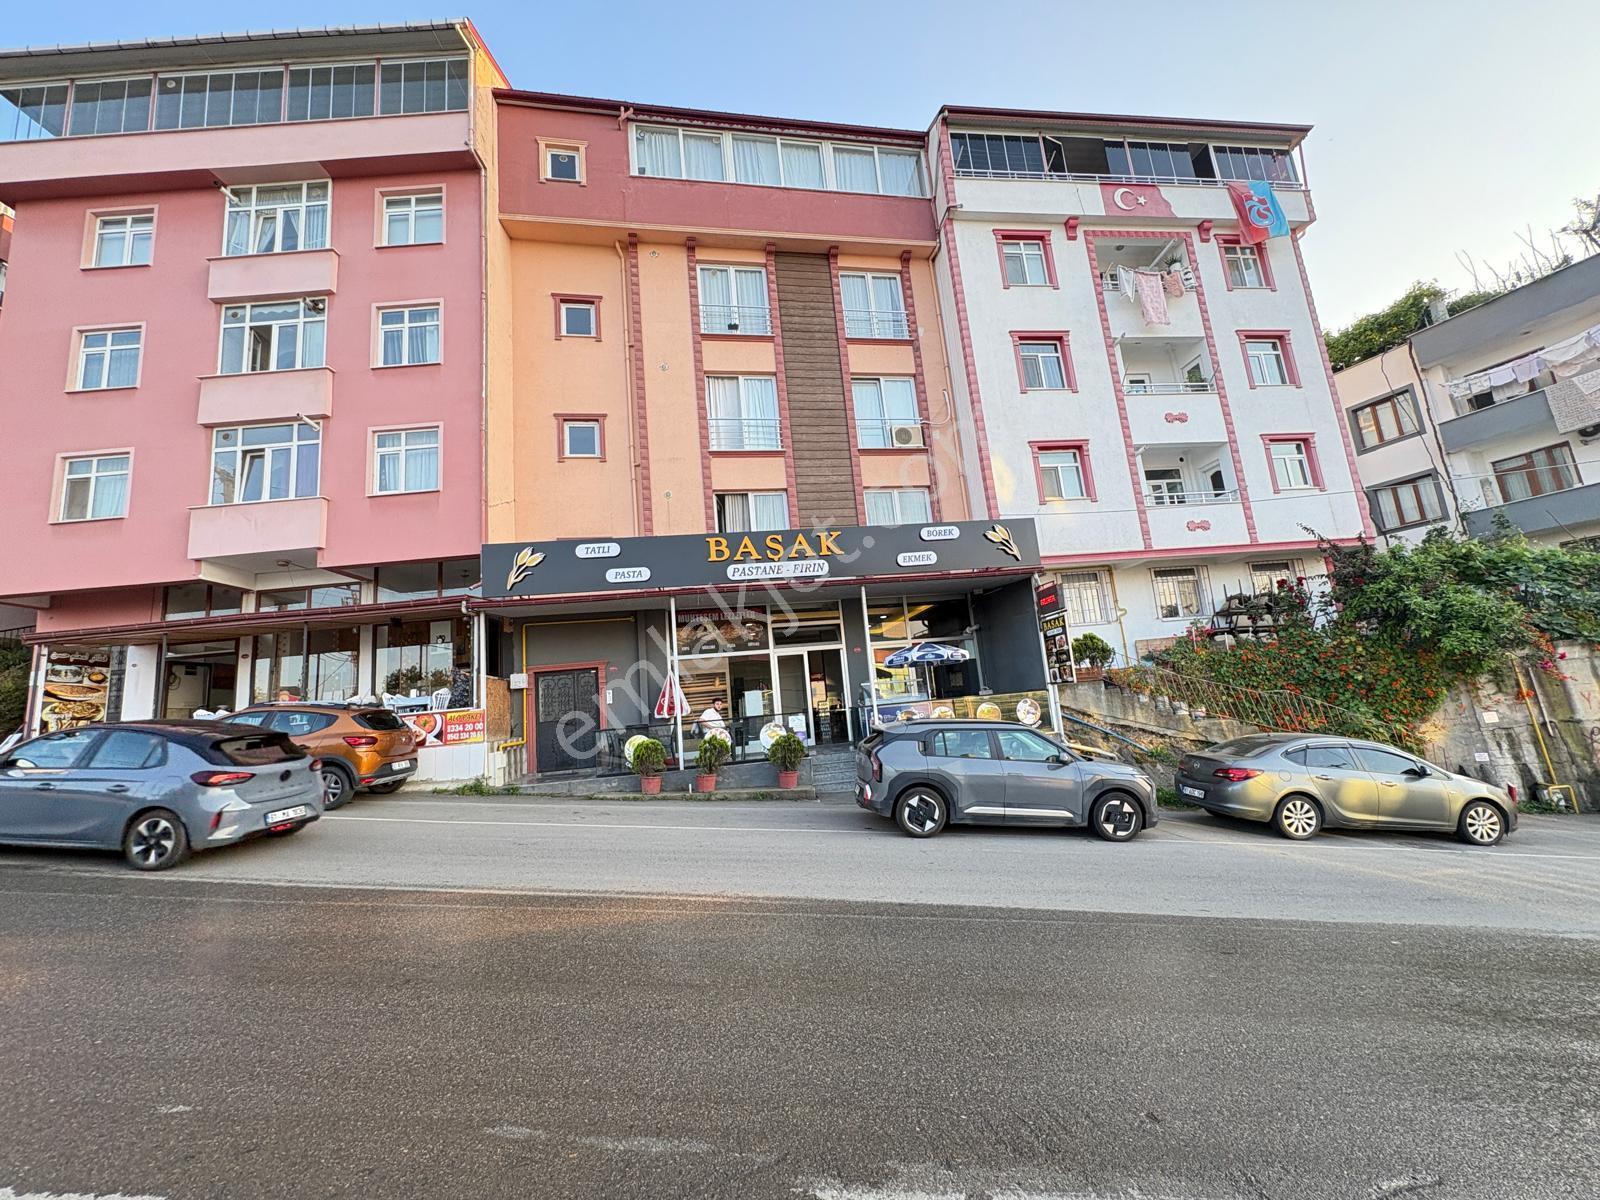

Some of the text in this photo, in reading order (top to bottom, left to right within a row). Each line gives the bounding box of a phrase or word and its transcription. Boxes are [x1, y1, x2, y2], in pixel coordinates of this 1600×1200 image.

[926, 527, 955, 537] BÖREK
[584, 545, 611, 555] TATLI
[706, 531, 845, 562] BAŞAK
[902, 553, 932, 563] EKMEK
[614, 569, 643, 579] PASTA
[731, 564, 784, 577] PASTANE
[793, 562, 826, 574] FIRIN
[464, 723, 474, 731] 20
[474, 722, 484, 730] 00
